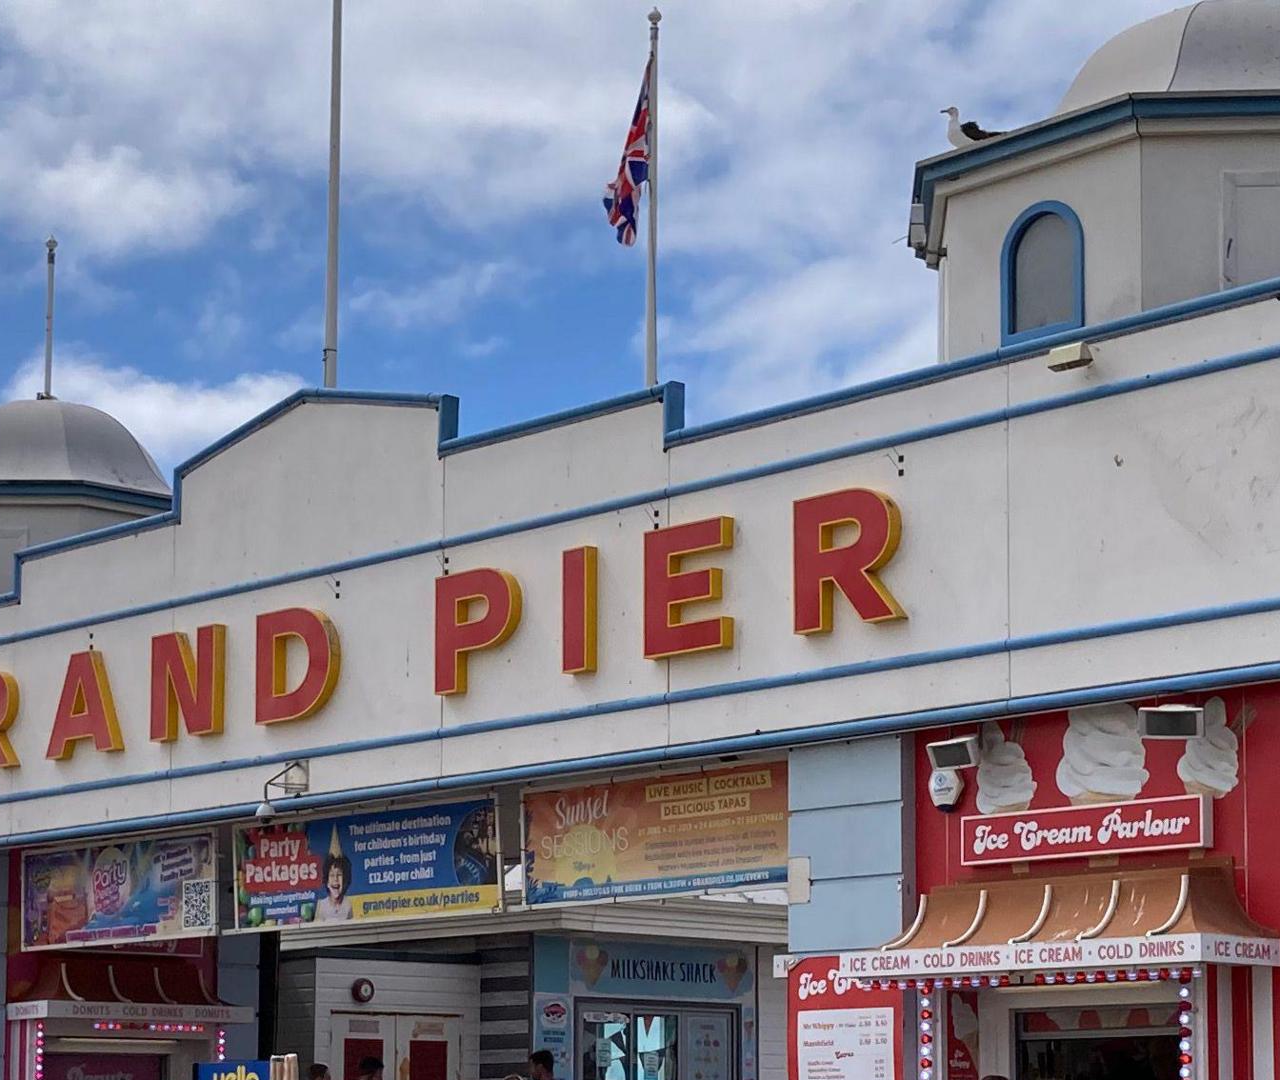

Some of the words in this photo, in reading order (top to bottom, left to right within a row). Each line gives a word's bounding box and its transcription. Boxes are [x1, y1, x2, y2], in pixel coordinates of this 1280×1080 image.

[435, 488, 907, 696] PIER
[649, 787, 670, 799] LIVE
[673, 782, 704, 796] MUSIC
[714, 774, 767, 789] COCKTAILS
[664, 798, 715, 816] DELICIOUS
[719, 797, 747, 809] TAPAS
[349, 824, 364, 835] The
[365, 819, 400, 833] ultimate
[402, 814, 451, 830] destination
[973, 824, 1008, 854] Ice
[1014, 821, 1092, 850] Cream
[1098, 808, 1190, 844] Parlour
[260, 839, 301, 861] Party
[355, 840, 366, 852] for
[367, 836, 408, 850] children's
[408, 833, 446, 848] birthday
[541, 826, 629, 860] SESSIONS
[364, 856, 394, 870] parties
[400, 853, 420, 863] from
[419, 850, 436, 865] just
[246, 863, 318, 885] Packages
[394, 872, 409, 884] per
[363, 891, 480, 914] grandpier.co.uk/parties
[850, 956, 867, 972] ICE
[871, 954, 910, 971] CREAM
[923, 953, 954, 968] COLD
[959, 949, 1000, 966] DRINKS
[1014, 948, 1034, 964] ICE
[1039, 945, 1082, 962] CREAM
[1098, 943, 1133, 960] COLD
[1139, 940, 1185, 957] DRINKS
[1214, 940, 1232, 957] ICE
[1234, 941, 1271, 960] CREAM
[610, 959, 676, 982] MILKSHAKE
[680, 963, 716, 984] SHACK
[798, 973, 827, 1000] Ice
[72, 1005, 111, 1015] DONUTS
[123, 1006, 147, 1016] COLD
[152, 1007, 184, 1017] DRINKS
[195, 1008, 230, 1019] DONUTS
